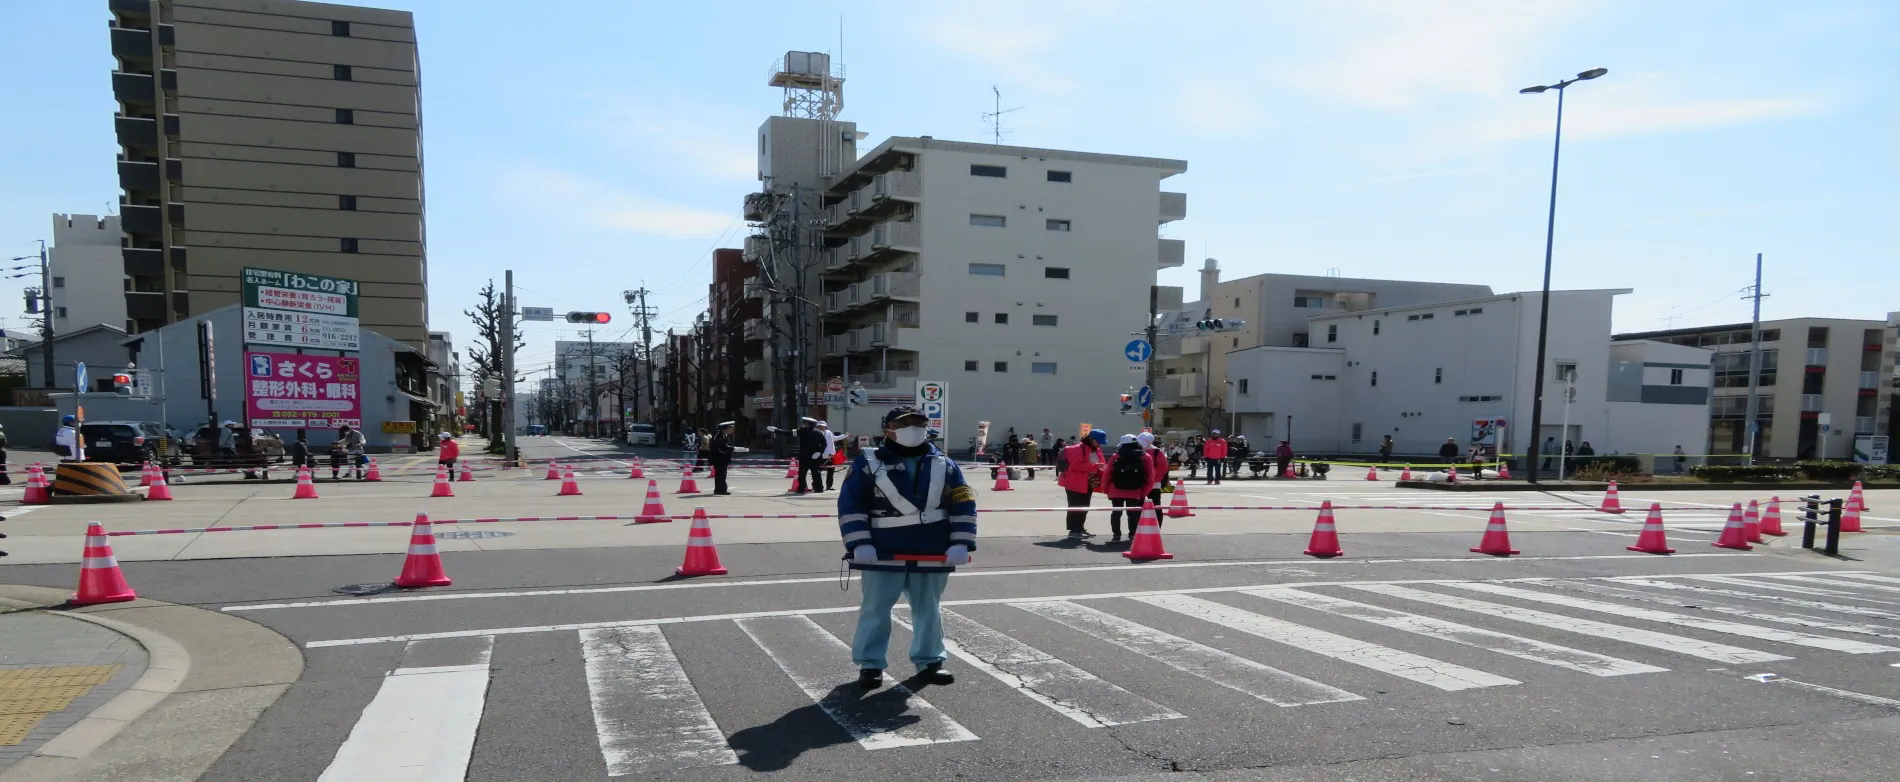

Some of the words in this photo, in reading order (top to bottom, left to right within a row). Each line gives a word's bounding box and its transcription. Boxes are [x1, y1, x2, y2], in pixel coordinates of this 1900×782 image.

[247, 311, 292, 322] 入居時費用
[277, 360, 333, 379] さくら
[251, 379, 357, 399] 整形外科・眼科
[924, 403, 940, 418] P
